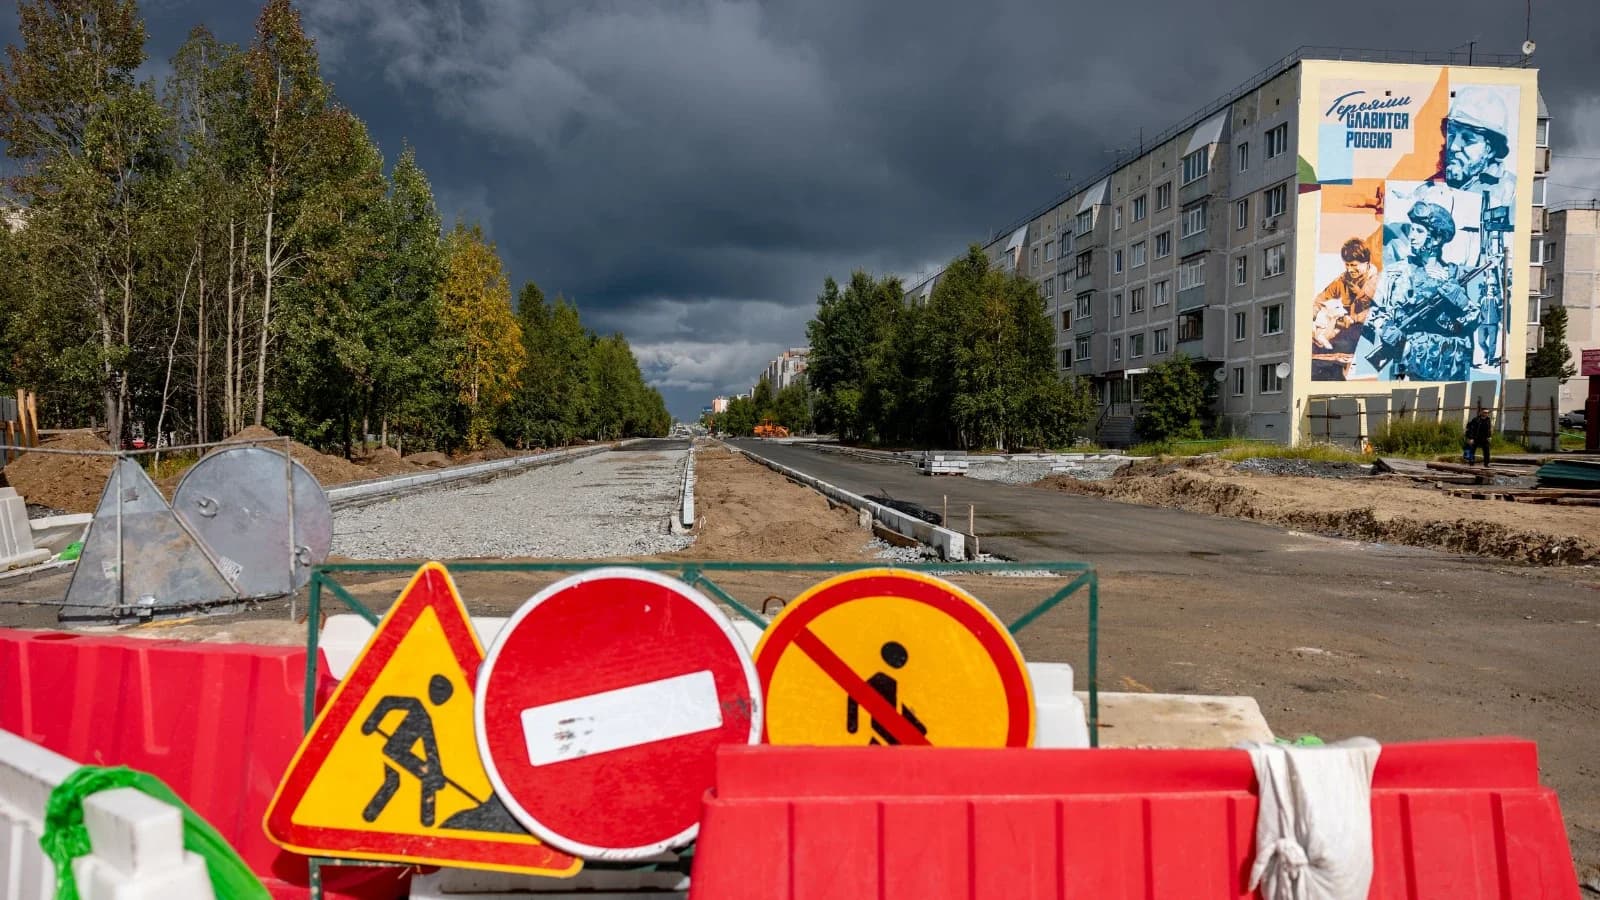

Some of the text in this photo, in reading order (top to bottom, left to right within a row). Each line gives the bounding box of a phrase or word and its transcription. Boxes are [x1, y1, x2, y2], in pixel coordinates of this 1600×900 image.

[1325, 90, 1412, 121] Героями
[1346, 111, 1409, 129] СЛАВИТСЯ
[1346, 130, 1392, 149] РОССИЯ
